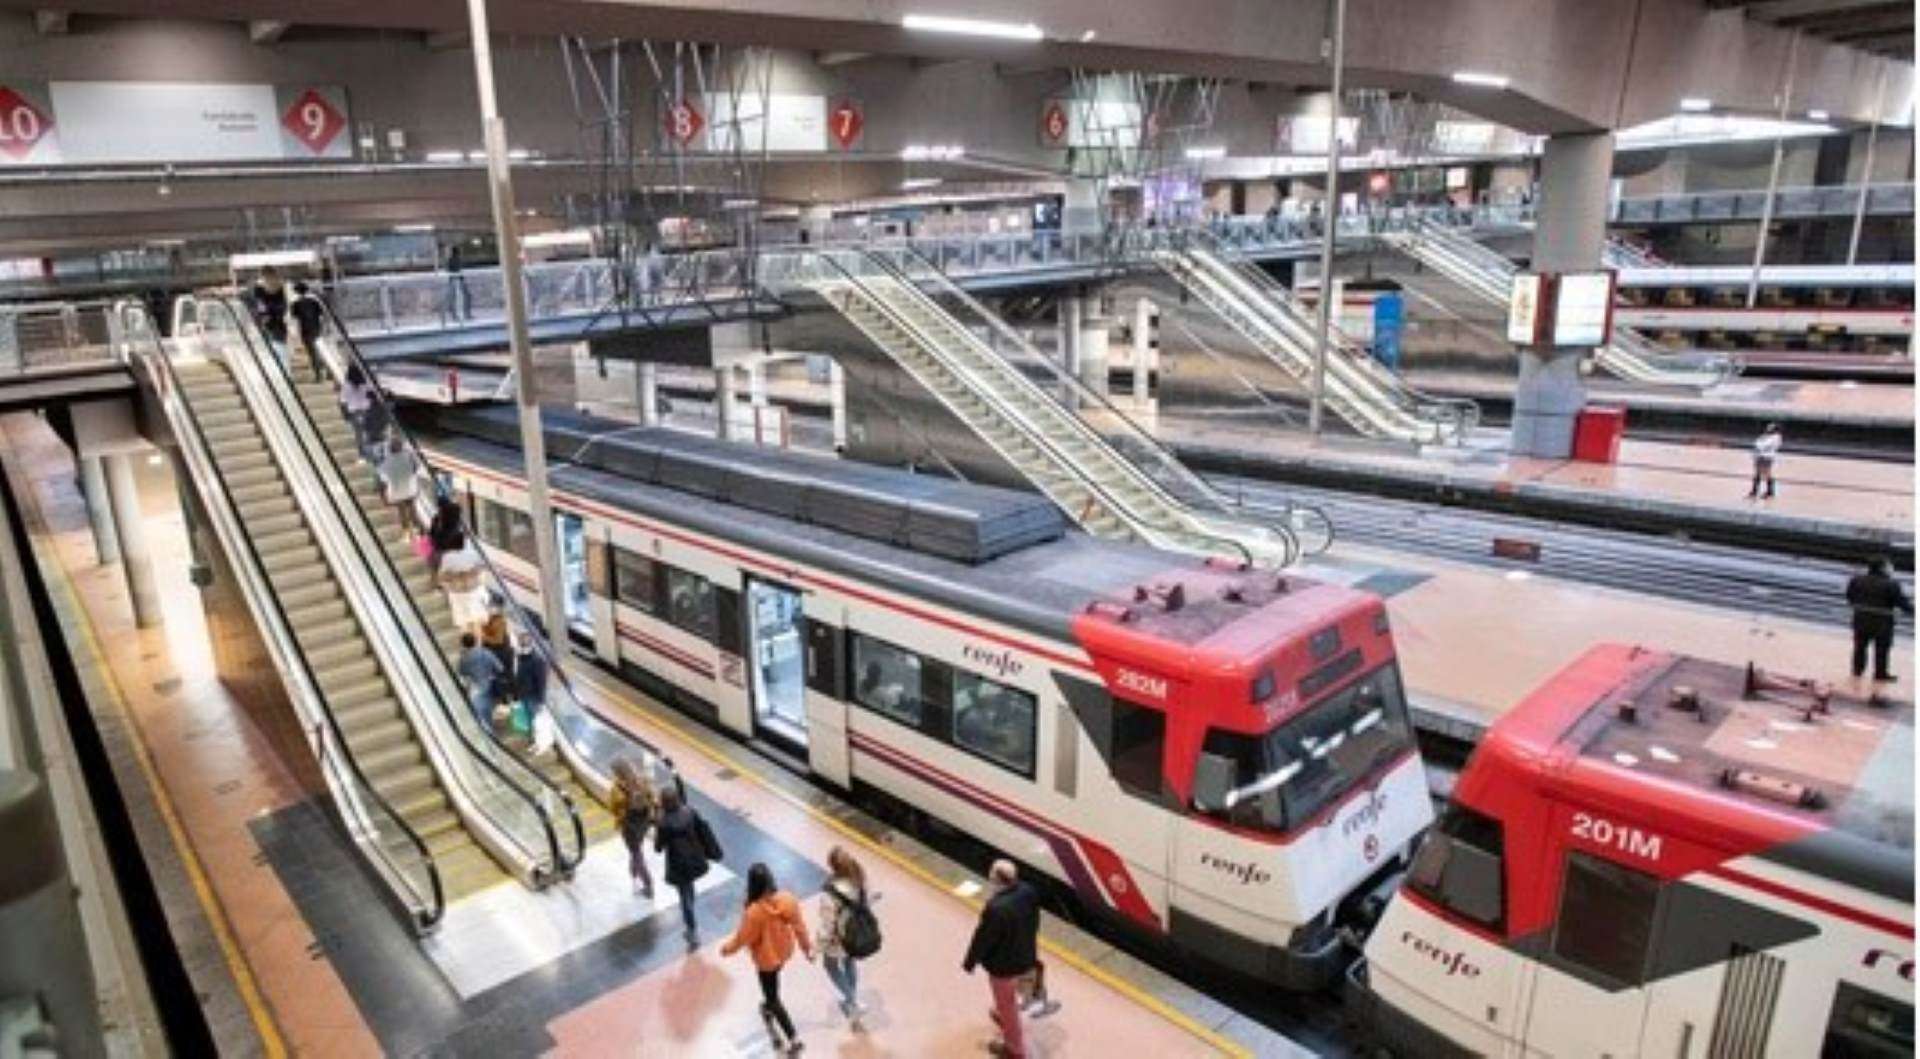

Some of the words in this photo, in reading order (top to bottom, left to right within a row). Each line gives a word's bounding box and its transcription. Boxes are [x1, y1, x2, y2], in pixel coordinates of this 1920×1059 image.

[301, 102, 325, 140] 9
[673, 107, 691, 137] 8
[838, 109, 854, 137] 7
[1571, 812, 1662, 861] 201M
[1201, 853, 1271, 886] renfe
[1402, 931, 1481, 978] renfe
